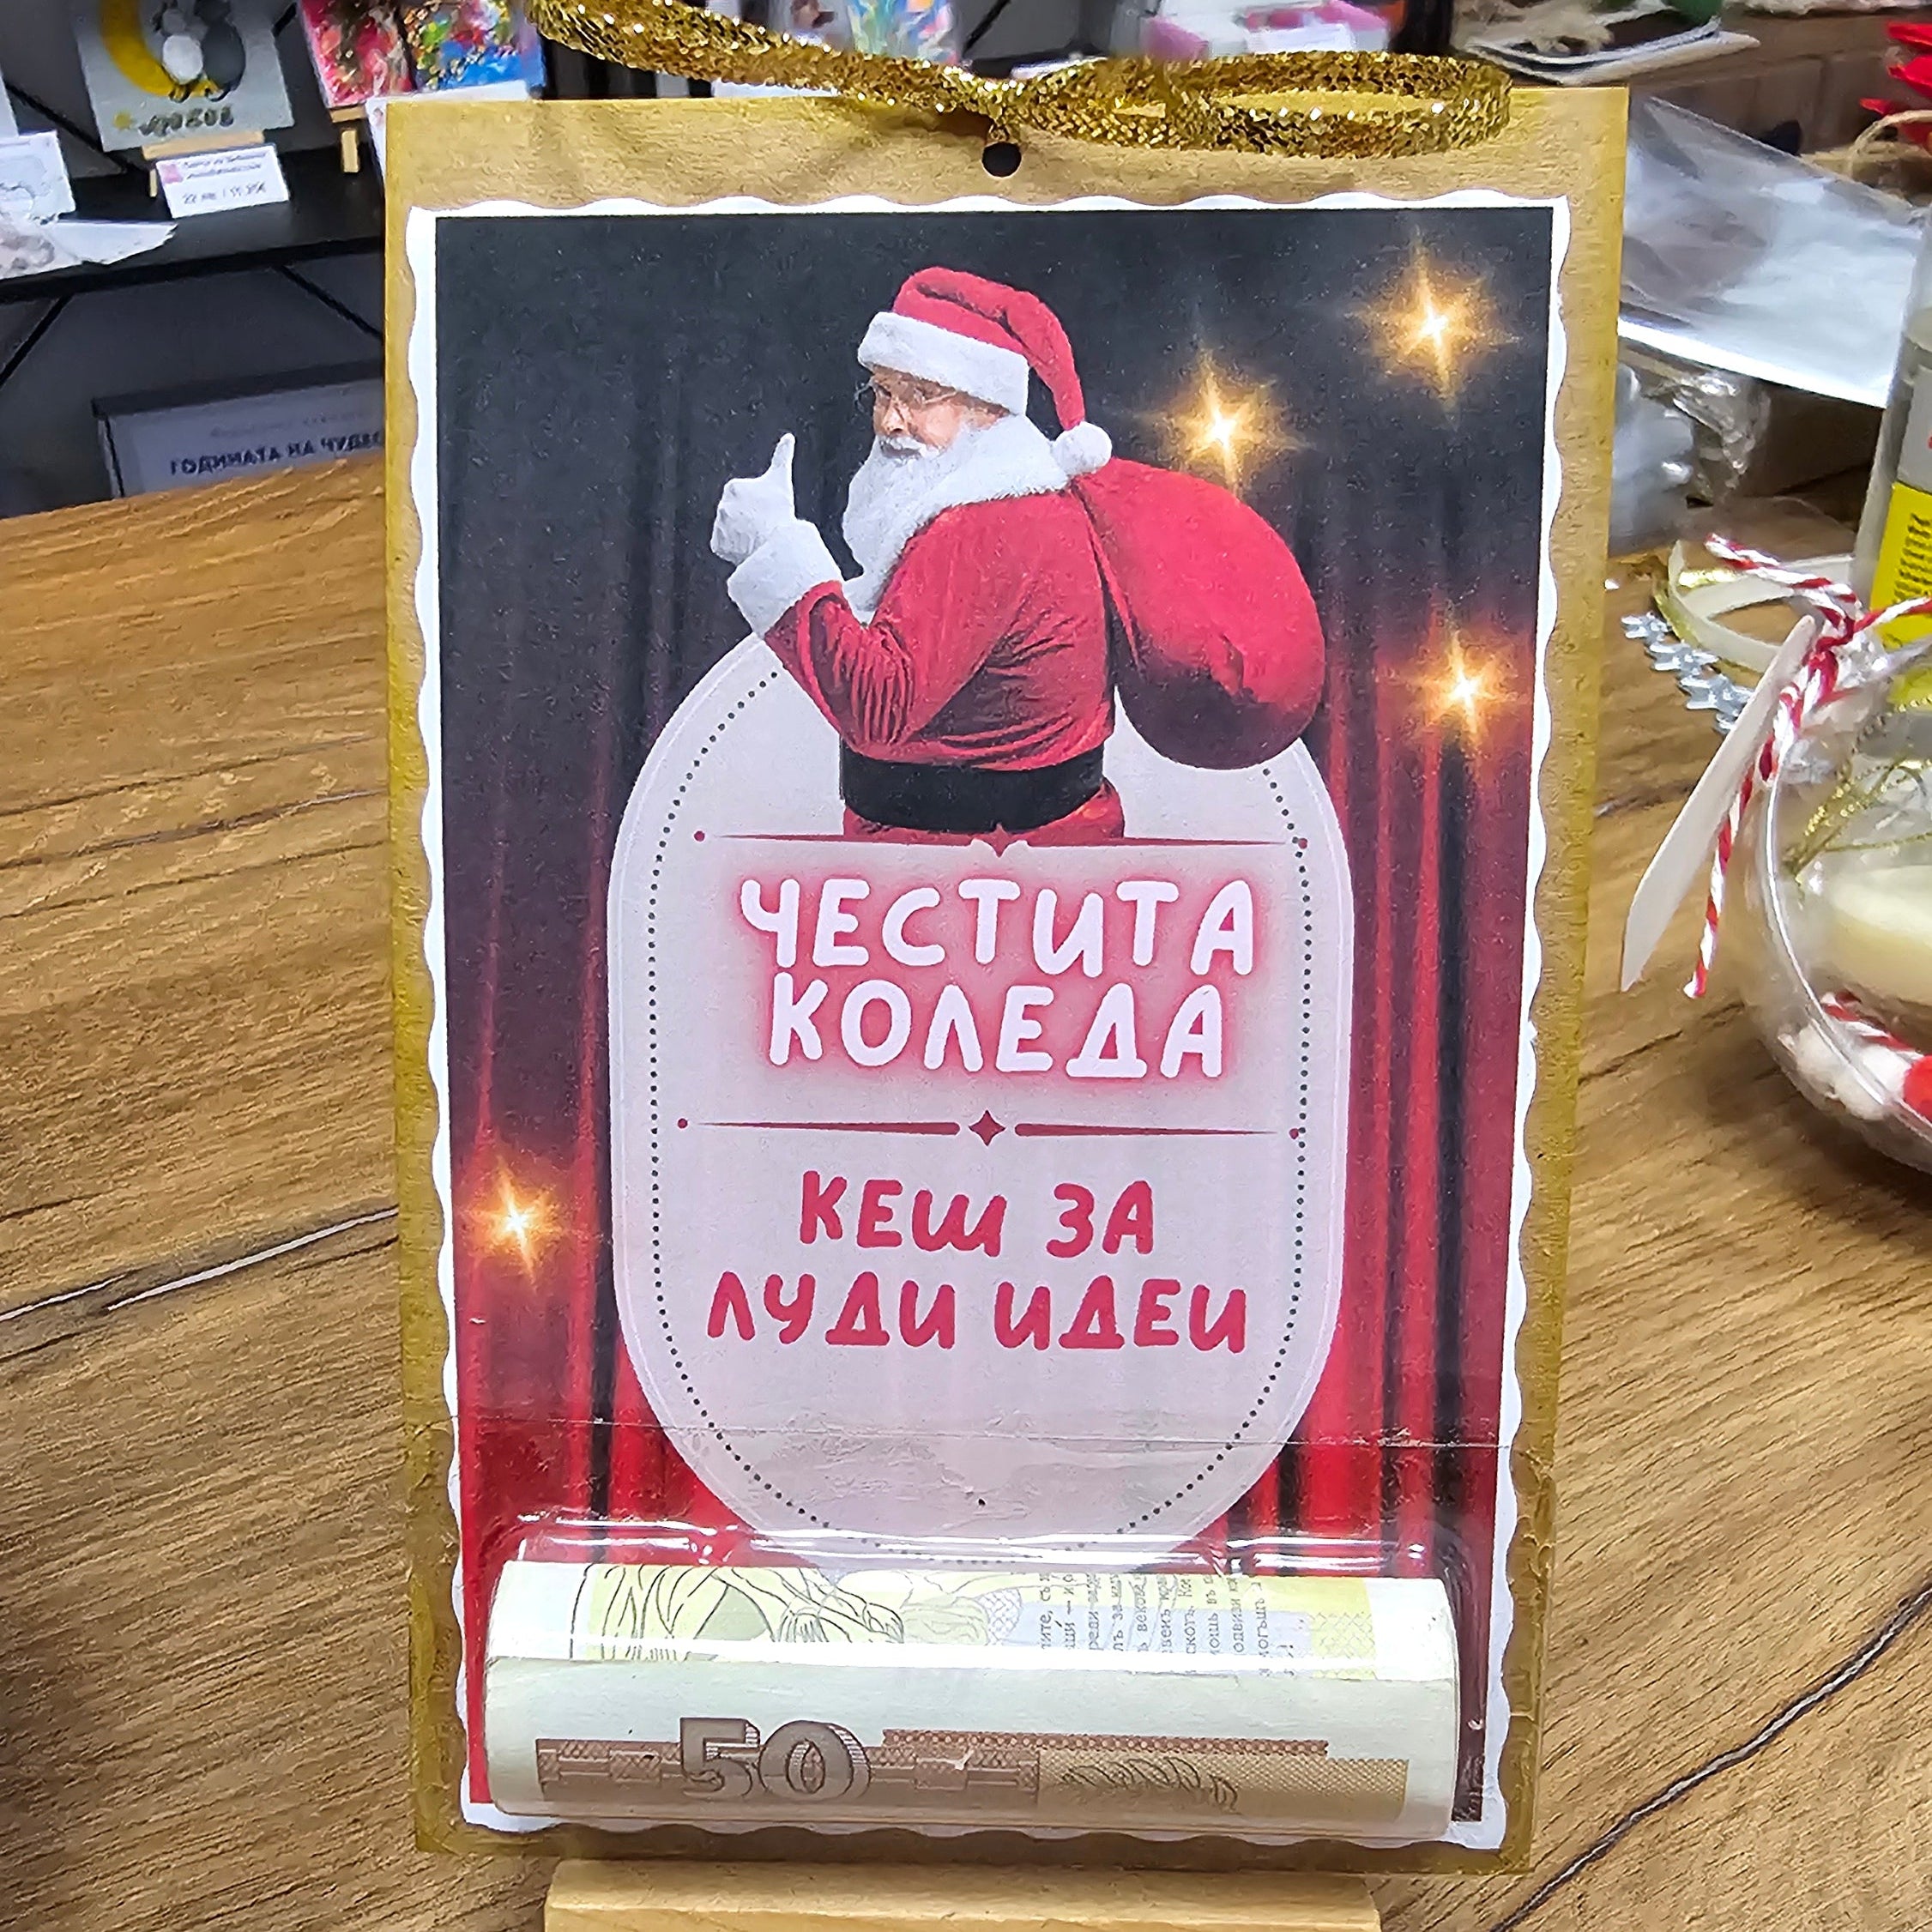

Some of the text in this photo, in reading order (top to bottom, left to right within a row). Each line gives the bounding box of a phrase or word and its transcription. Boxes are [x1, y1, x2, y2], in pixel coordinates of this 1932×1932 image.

[170, 445, 281, 475] ГОДИНАТА
[287, 438, 315, 458] НА
[740, 878, 1253, 977] ЧЕСТИТА
[769, 973, 1223, 1078] КОЛЕДА
[799, 1170, 1155, 1259] КЕШ ЗА
[706, 1271, 1247, 1354] ЛУДИ ИДЕИ
[680, 1717, 872, 1802] 50
